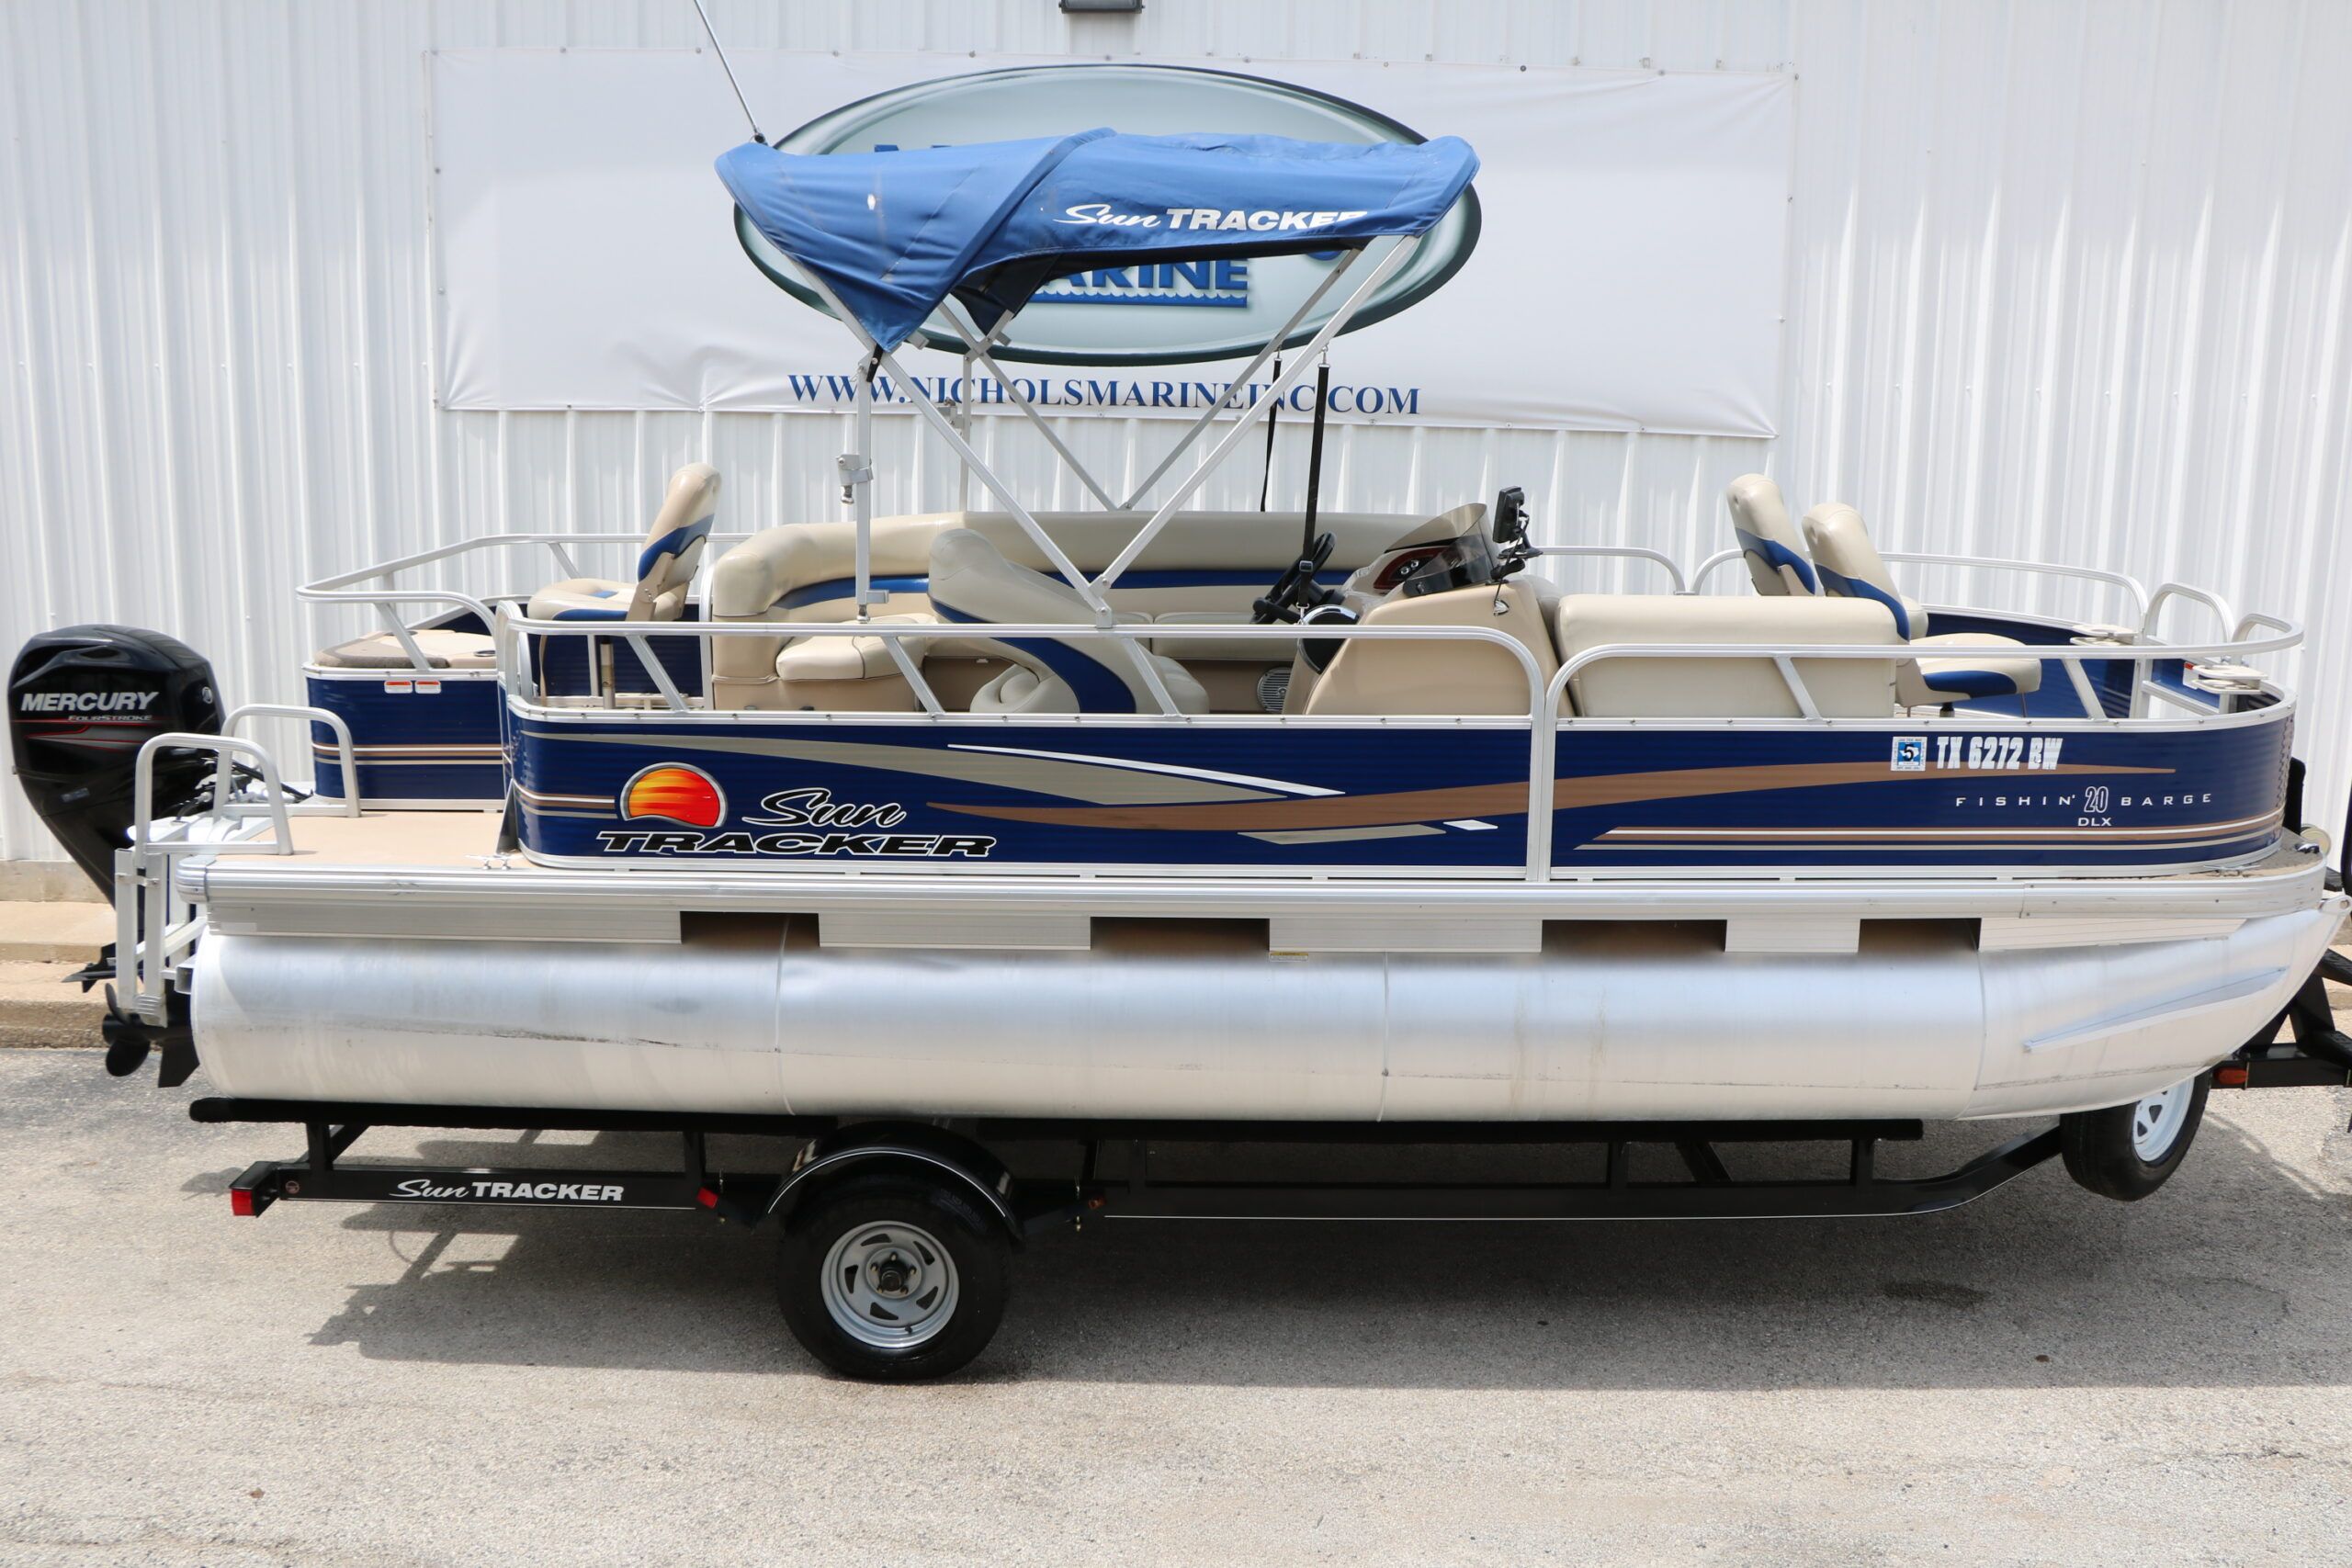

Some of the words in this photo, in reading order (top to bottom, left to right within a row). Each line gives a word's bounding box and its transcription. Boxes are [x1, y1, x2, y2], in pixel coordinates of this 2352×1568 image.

[1053, 204, 1159, 228] Sun
[21, 692, 159, 712] MERCURY
[1904, 744, 1915, 761] 5
[1937, 736, 1963, 769] TX
[1968, 736, 2024, 770] 6272
[2028, 737, 2064, 770] BW
[742, 787, 907, 828] Sun
[1955, 794, 2075, 807] FISHIN'
[2084, 785, 2109, 812] 20
[2120, 794, 2211, 806] BARGE
[2077, 817, 2111, 827] DLX
[596, 830, 997, 857] TRACKER
[390, 1179, 469, 1198] Sun
[471, 1181, 624, 1201] TRACKER
